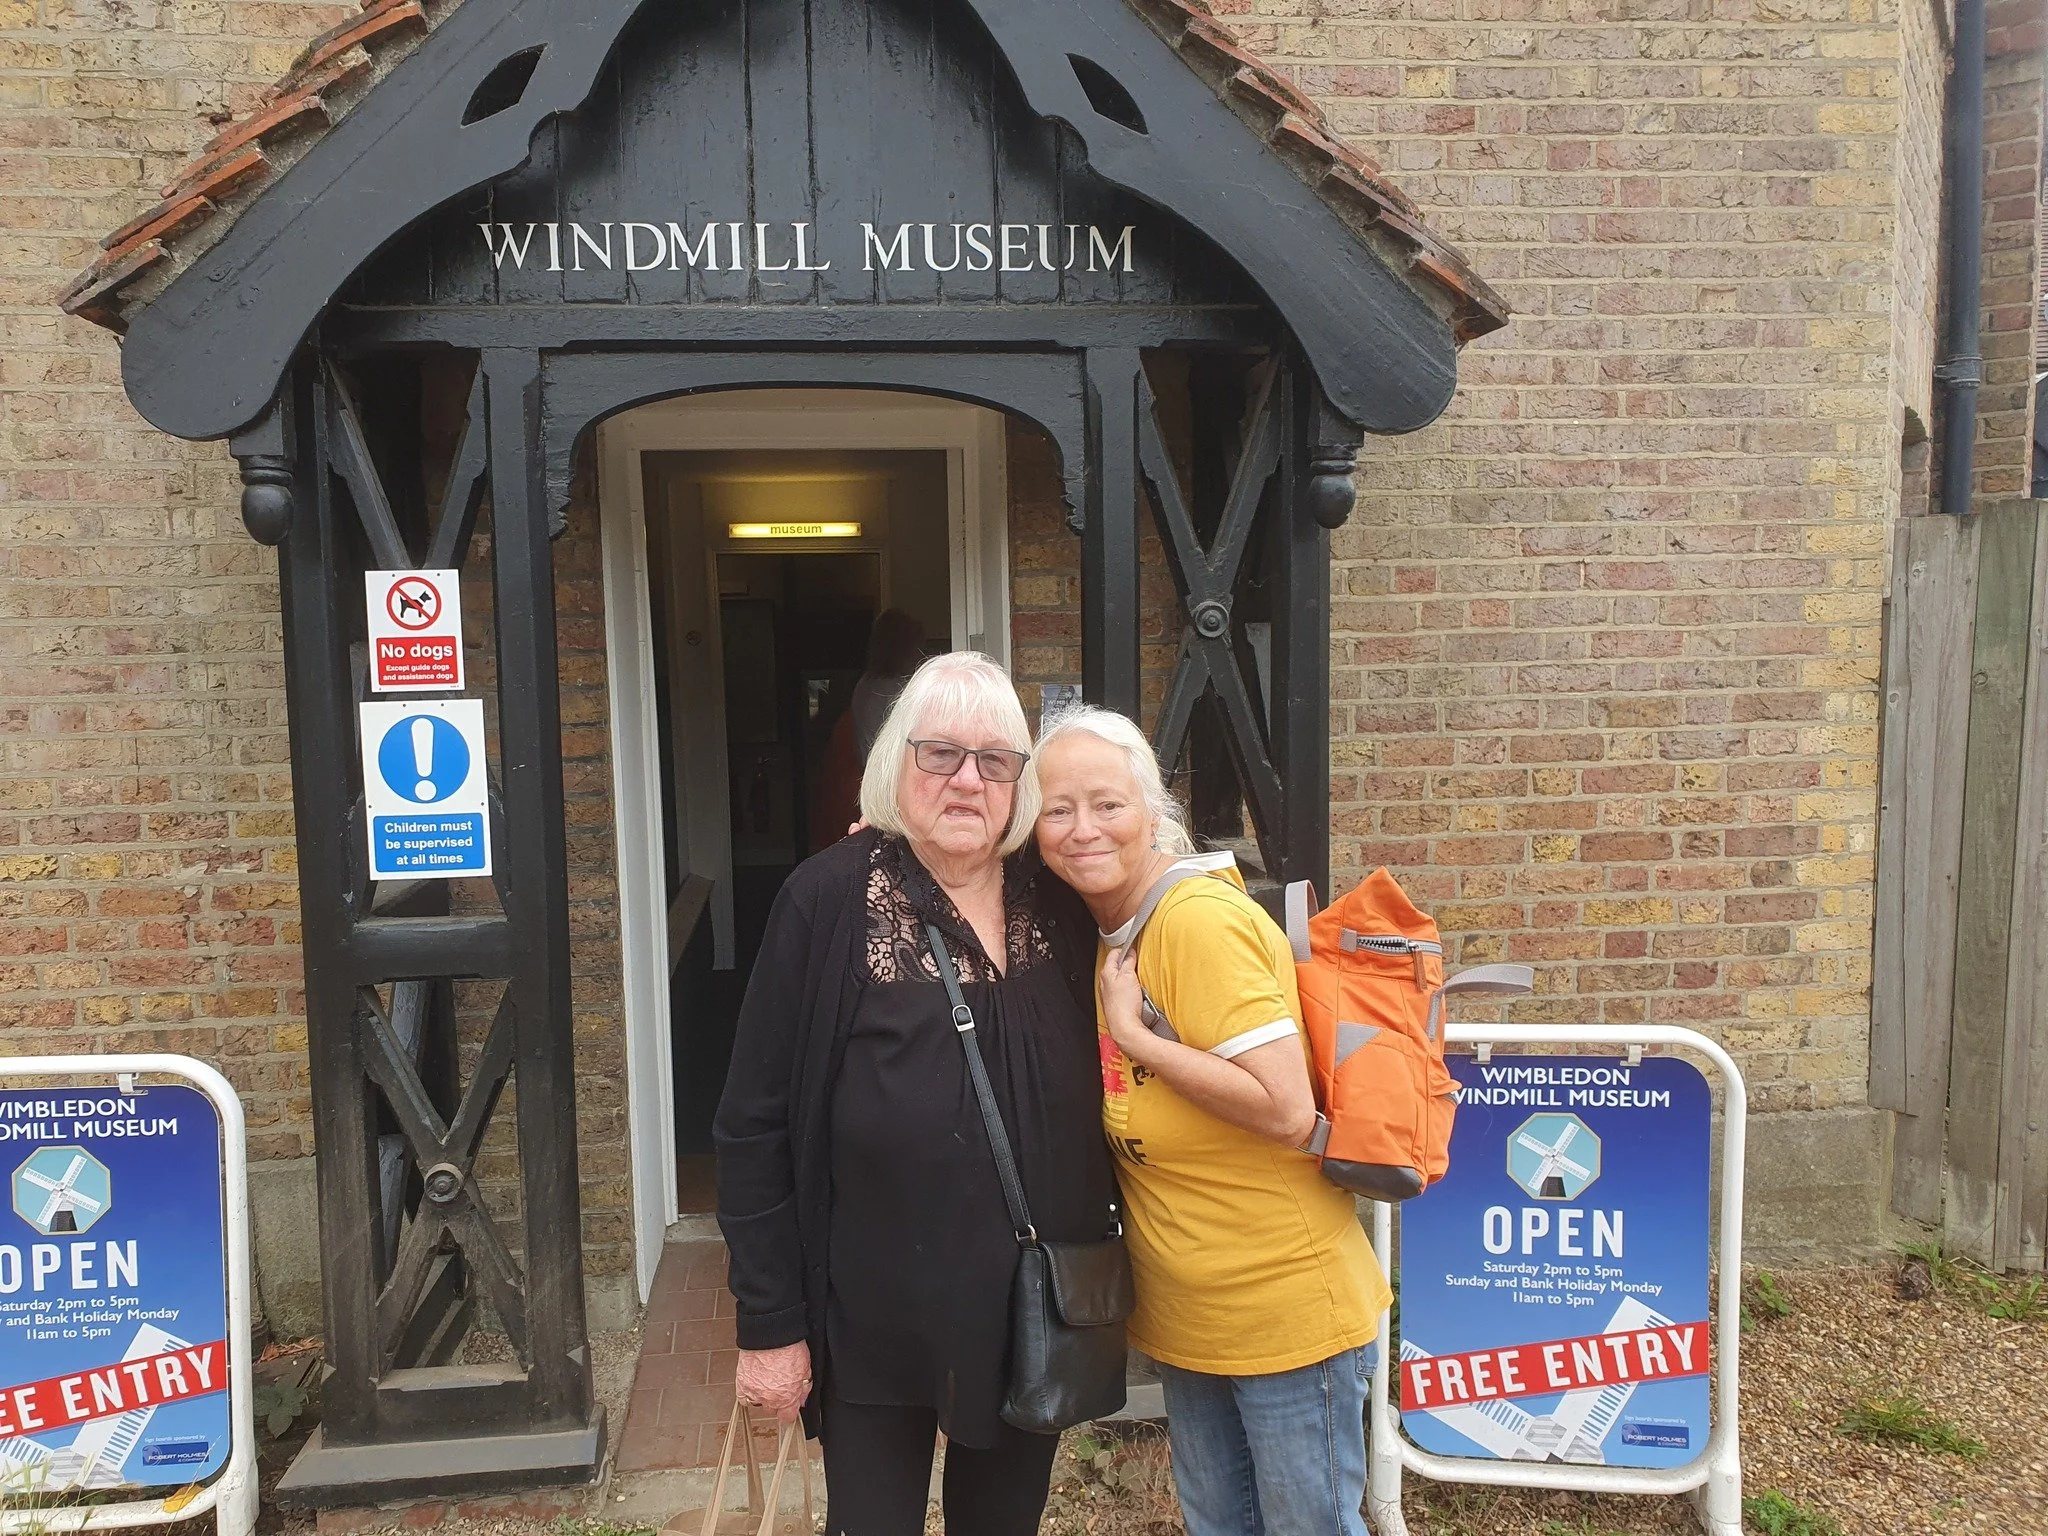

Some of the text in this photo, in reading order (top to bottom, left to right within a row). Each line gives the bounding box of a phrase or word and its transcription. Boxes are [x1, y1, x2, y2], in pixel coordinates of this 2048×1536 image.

[477, 222, 1137, 273] WINDMILL MUSEUM
[770, 525, 822, 534] museum
[381, 643, 453, 660] No dogs
[411, 664, 431, 672] guide
[436, 672, 454, 680] dogs
[385, 821, 472, 833] Children must
[385, 837, 472, 850] be supervised
[396, 853, 464, 866] at all times
[1481, 1067, 1630, 1086] WIMBLEDON
[1569, 1089, 1670, 1107] MUSEUM
[0, 1098, 136, 1119] IMBLEDON
[74, 1118, 178, 1139] MUSEUM
[1483, 1205, 1624, 1258] OPEN
[0, 1239, 139, 1294] OPEN
[1483, 1261, 1623, 1279] Saturday 2pm to 5pm
[1445, 1275, 1663, 1297] Sunday and Bank Holiday Monday
[57, 1298, 86, 1312] 2pm
[91, 1297, 106, 1308] to
[110, 1295, 139, 1310] 5pm
[1512, 1291, 1595, 1308] 11am to 5pm
[6, 1314, 31, 1327] and
[35, 1312, 68, 1325] Bank
[72, 1309, 123, 1324] Holiday
[127, 1307, 179, 1321] Monday
[26, 1325, 111, 1340] 11am to 5pm
[1410, 1327, 1697, 1405] FREE ENTRY
[60, 1347, 214, 1419] ENTRY
